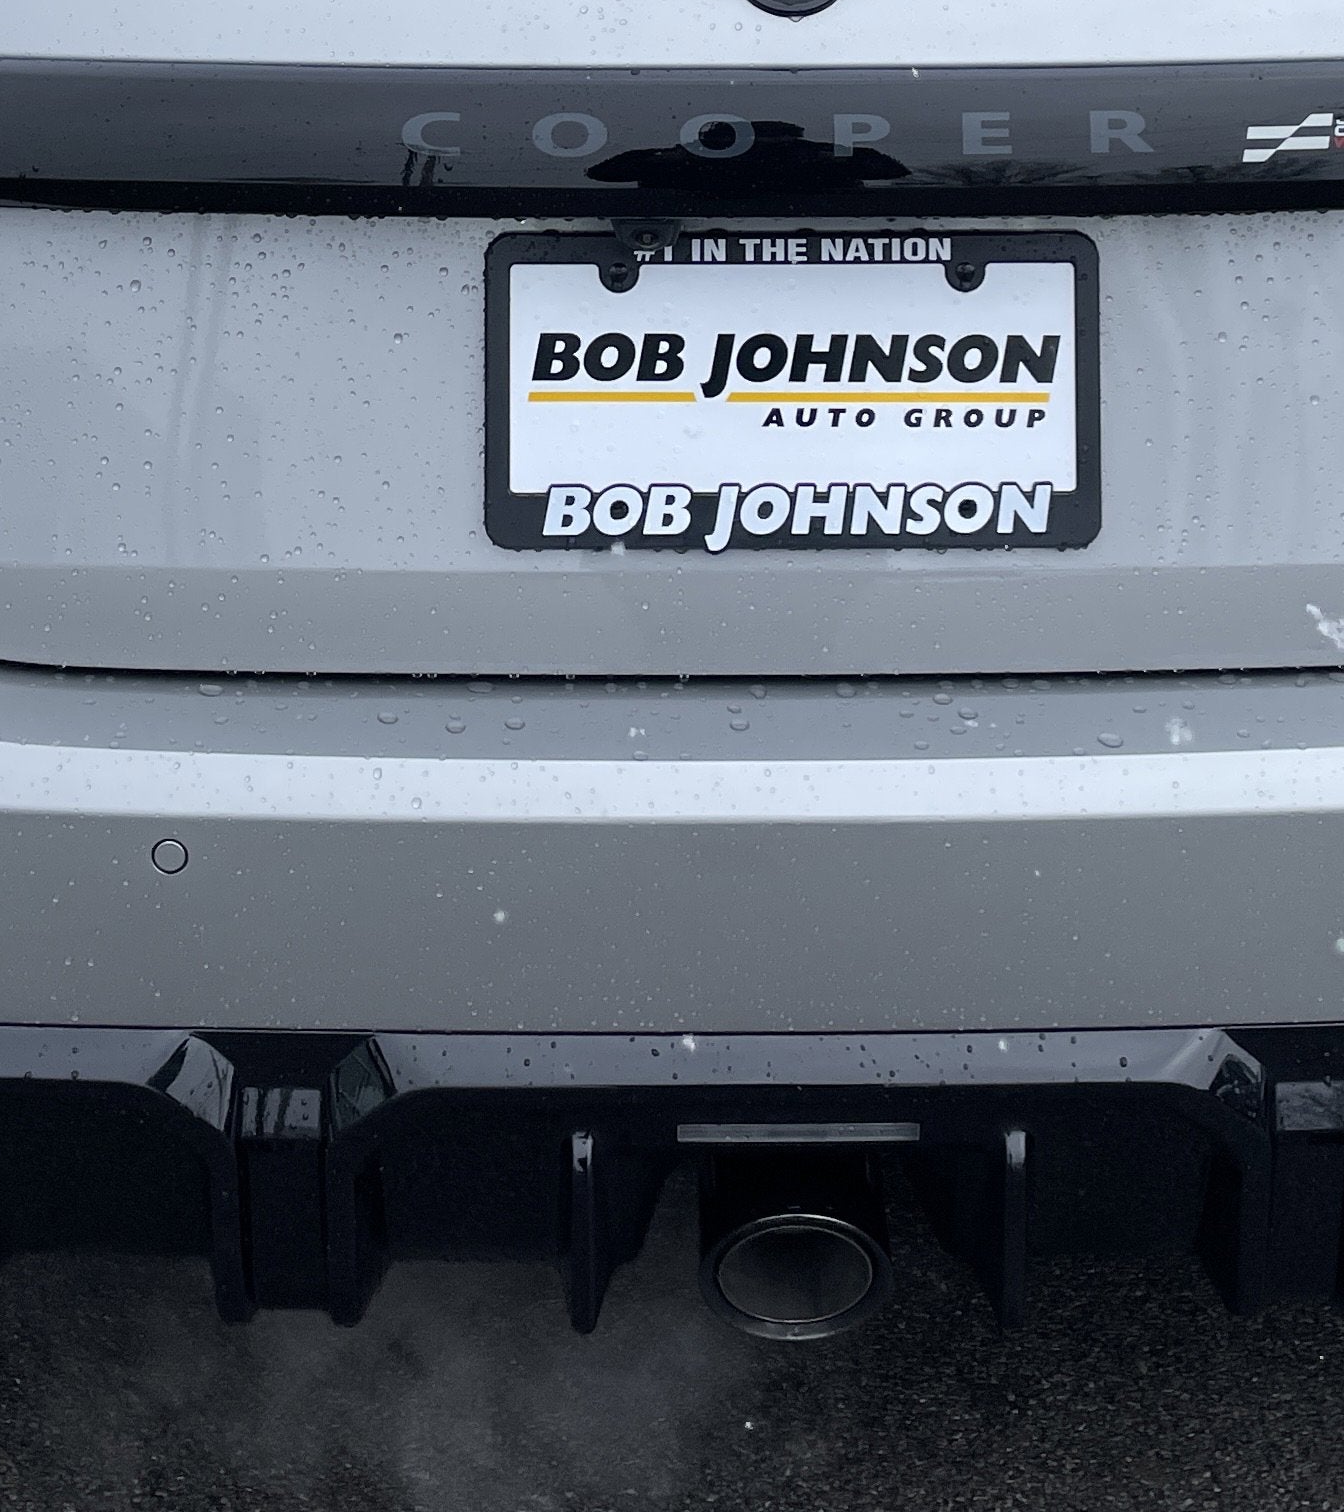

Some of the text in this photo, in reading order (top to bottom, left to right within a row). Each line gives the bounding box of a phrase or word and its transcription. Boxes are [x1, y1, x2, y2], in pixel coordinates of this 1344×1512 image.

[400, 108, 1155, 160] COOPER
[691, 238, 726, 261] IN
[739, 238, 808, 262] THE
[820, 238, 952, 261] NATION
[531, 332, 1061, 399] BOB JOHNSON
[761, 407, 1049, 428] AUTO GROUP
[542, 481, 1052, 554] BOB JOHNSON
